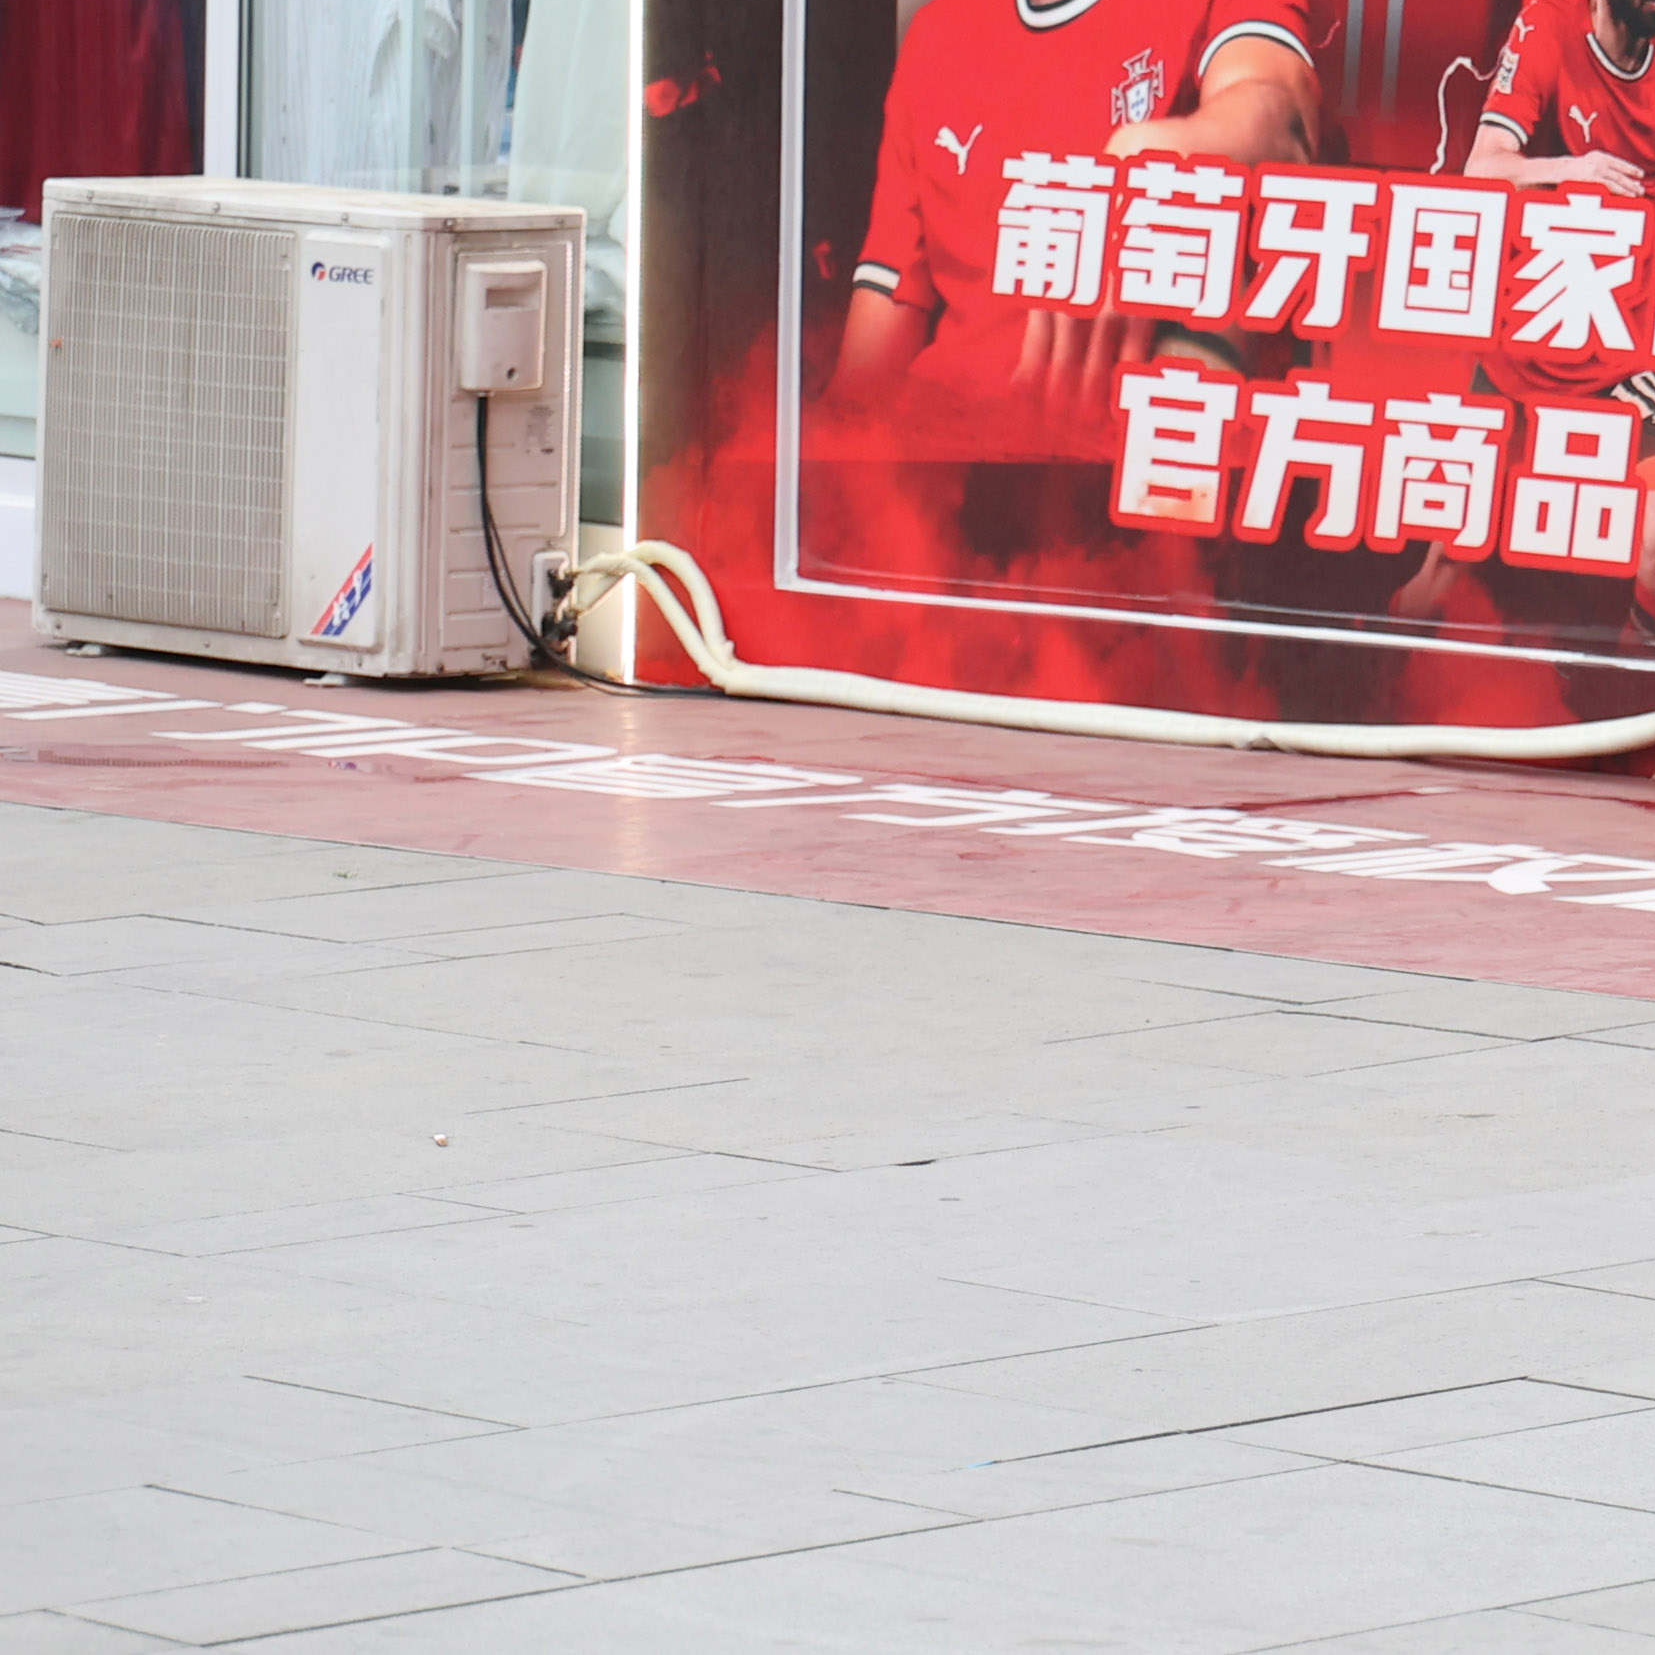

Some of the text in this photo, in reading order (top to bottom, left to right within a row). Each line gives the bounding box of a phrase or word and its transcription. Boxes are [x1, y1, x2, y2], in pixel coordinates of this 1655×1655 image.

[329, 265, 375, 286] GREE
[1116, 369, 1640, 565] 官方商品
